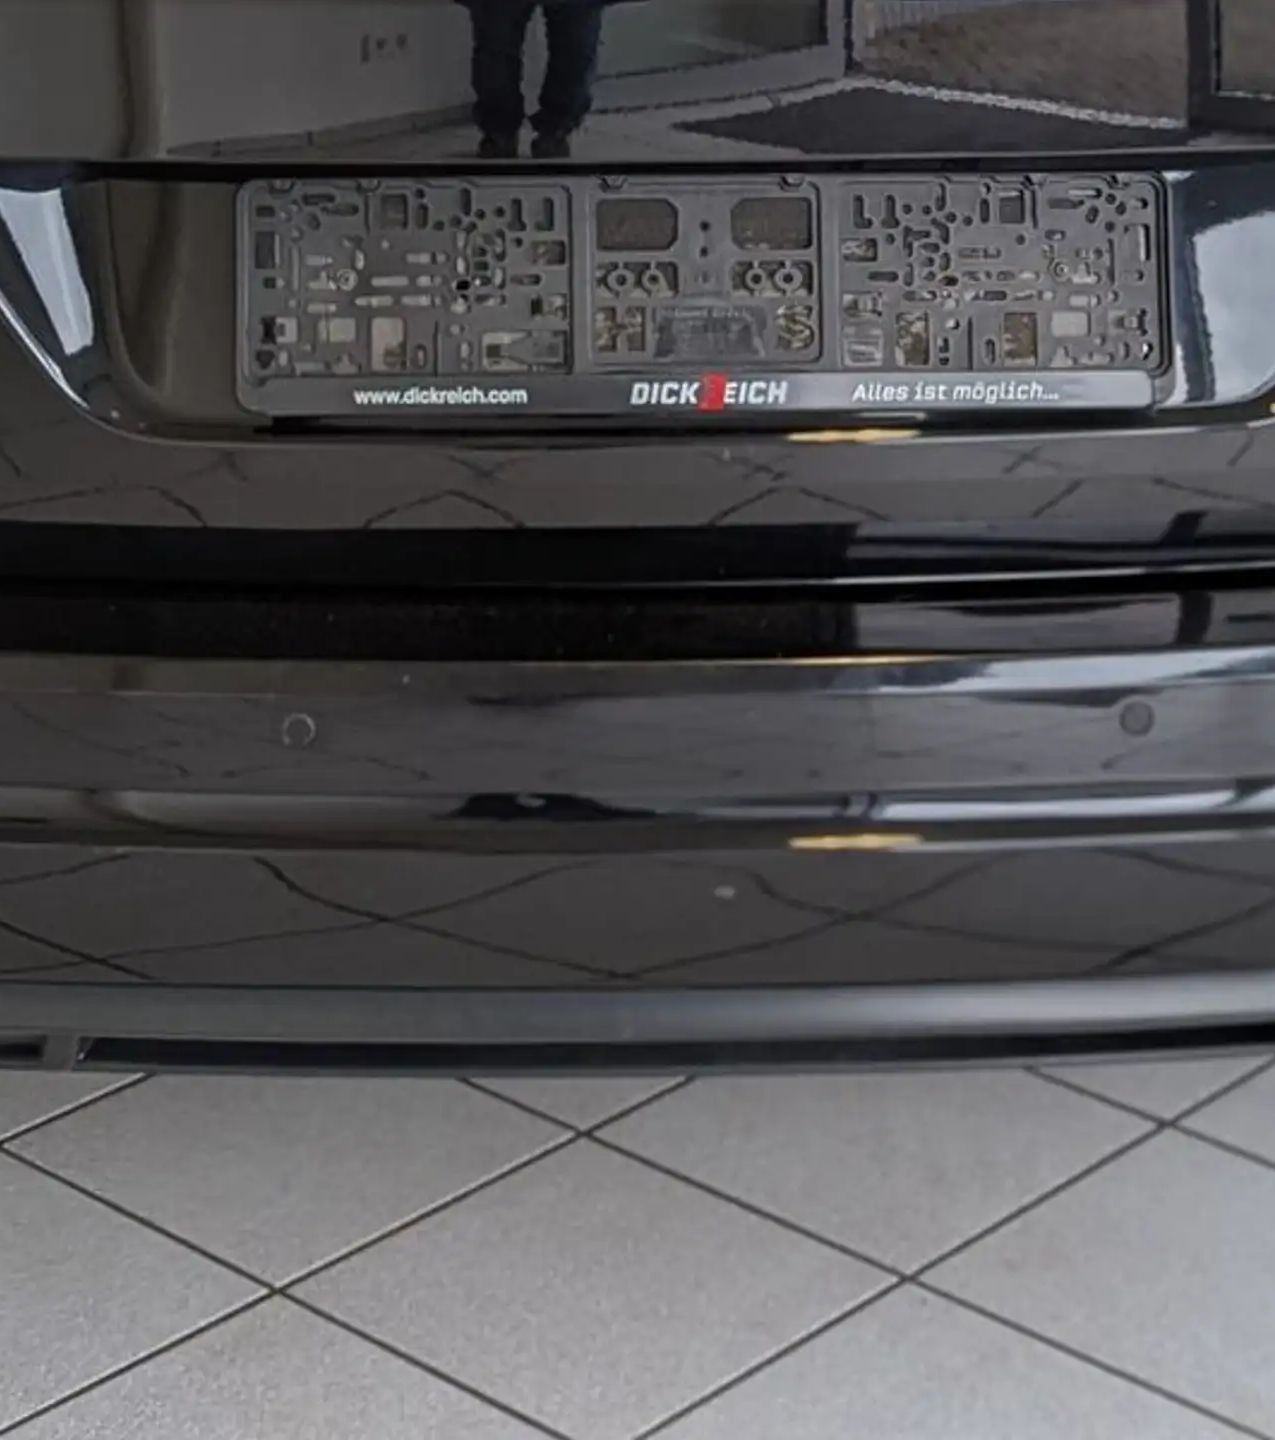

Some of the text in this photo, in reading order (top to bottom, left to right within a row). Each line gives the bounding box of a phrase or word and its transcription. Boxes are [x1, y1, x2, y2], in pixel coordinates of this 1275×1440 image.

[352, 385, 529, 405] www.dickreich.com
[852, 380, 1060, 405] Alles ist möglich...
